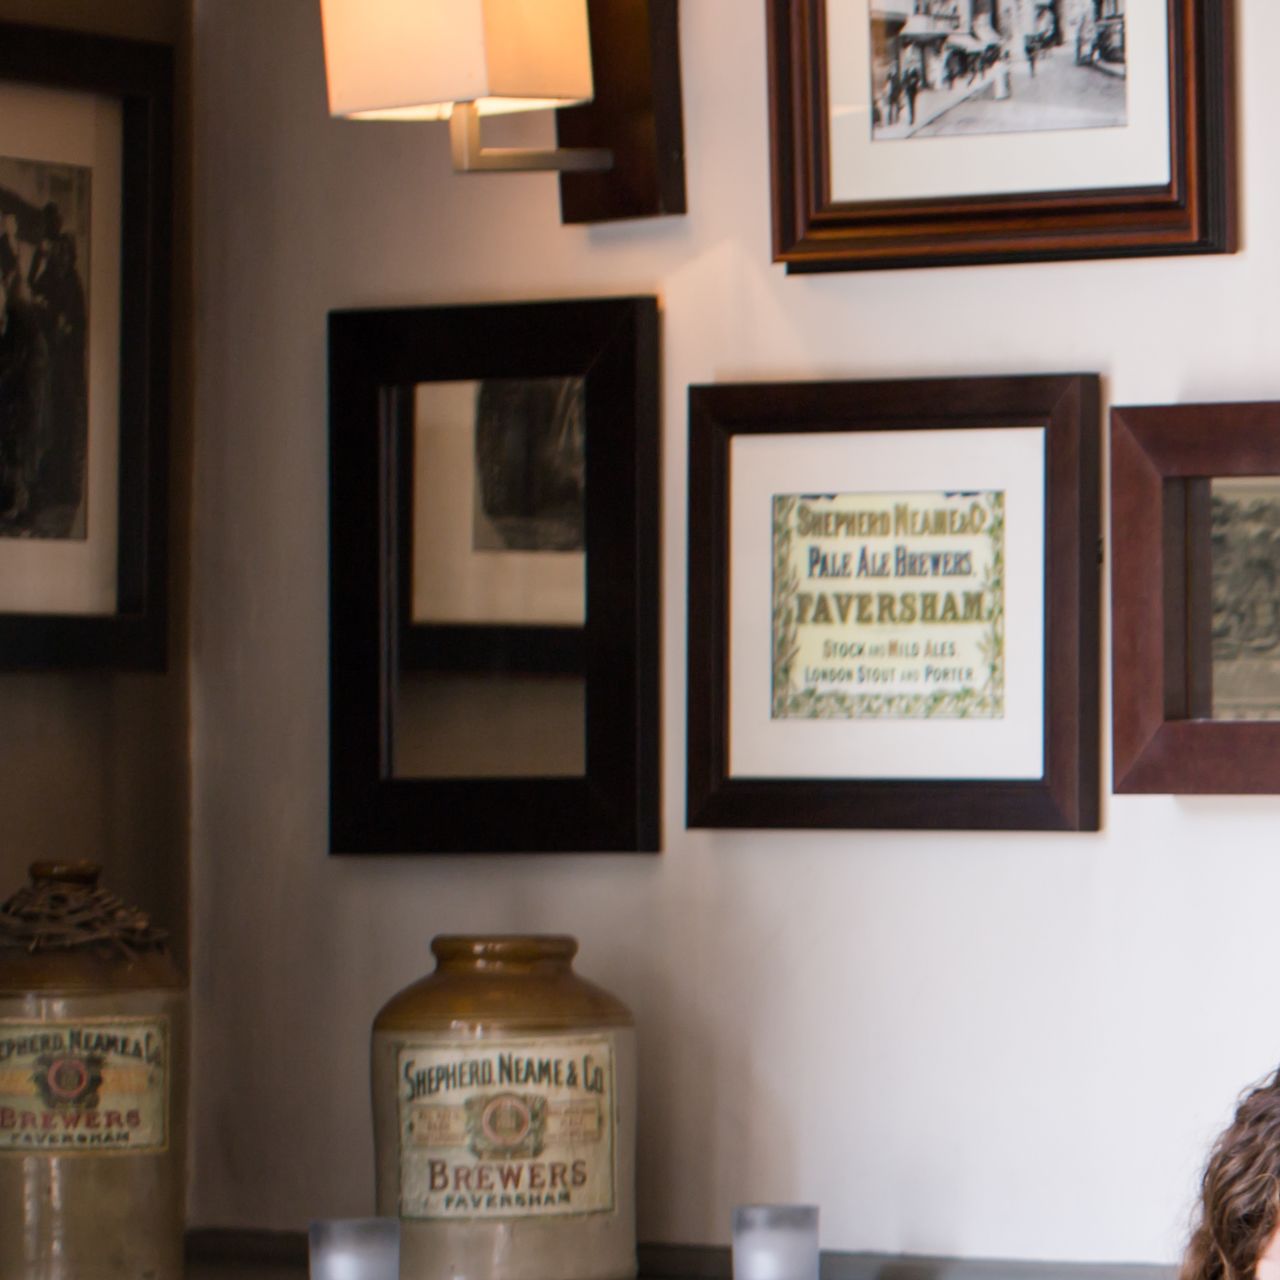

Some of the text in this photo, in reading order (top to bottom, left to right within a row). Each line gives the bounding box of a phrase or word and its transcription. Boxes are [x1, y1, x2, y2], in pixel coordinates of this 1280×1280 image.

[808, 546, 851, 578] PALE
[856, 544, 890, 577] ALE
[823, 640, 863, 658] STOCK
[888, 640, 919, 657] MILD
[804, 666, 853, 684] LONDON
[857, 665, 897, 683] STOUT
[68, 1029, 129, 1055] NEAME
[498, 1051, 564, 1087] NEAME
[566, 1059, 578, 1088] &
[0, 1106, 140, 1130] BREWERS
[428, 1159, 588, 1192] BREWERS
[444, 1191, 571, 1210] FAVERSHAM
